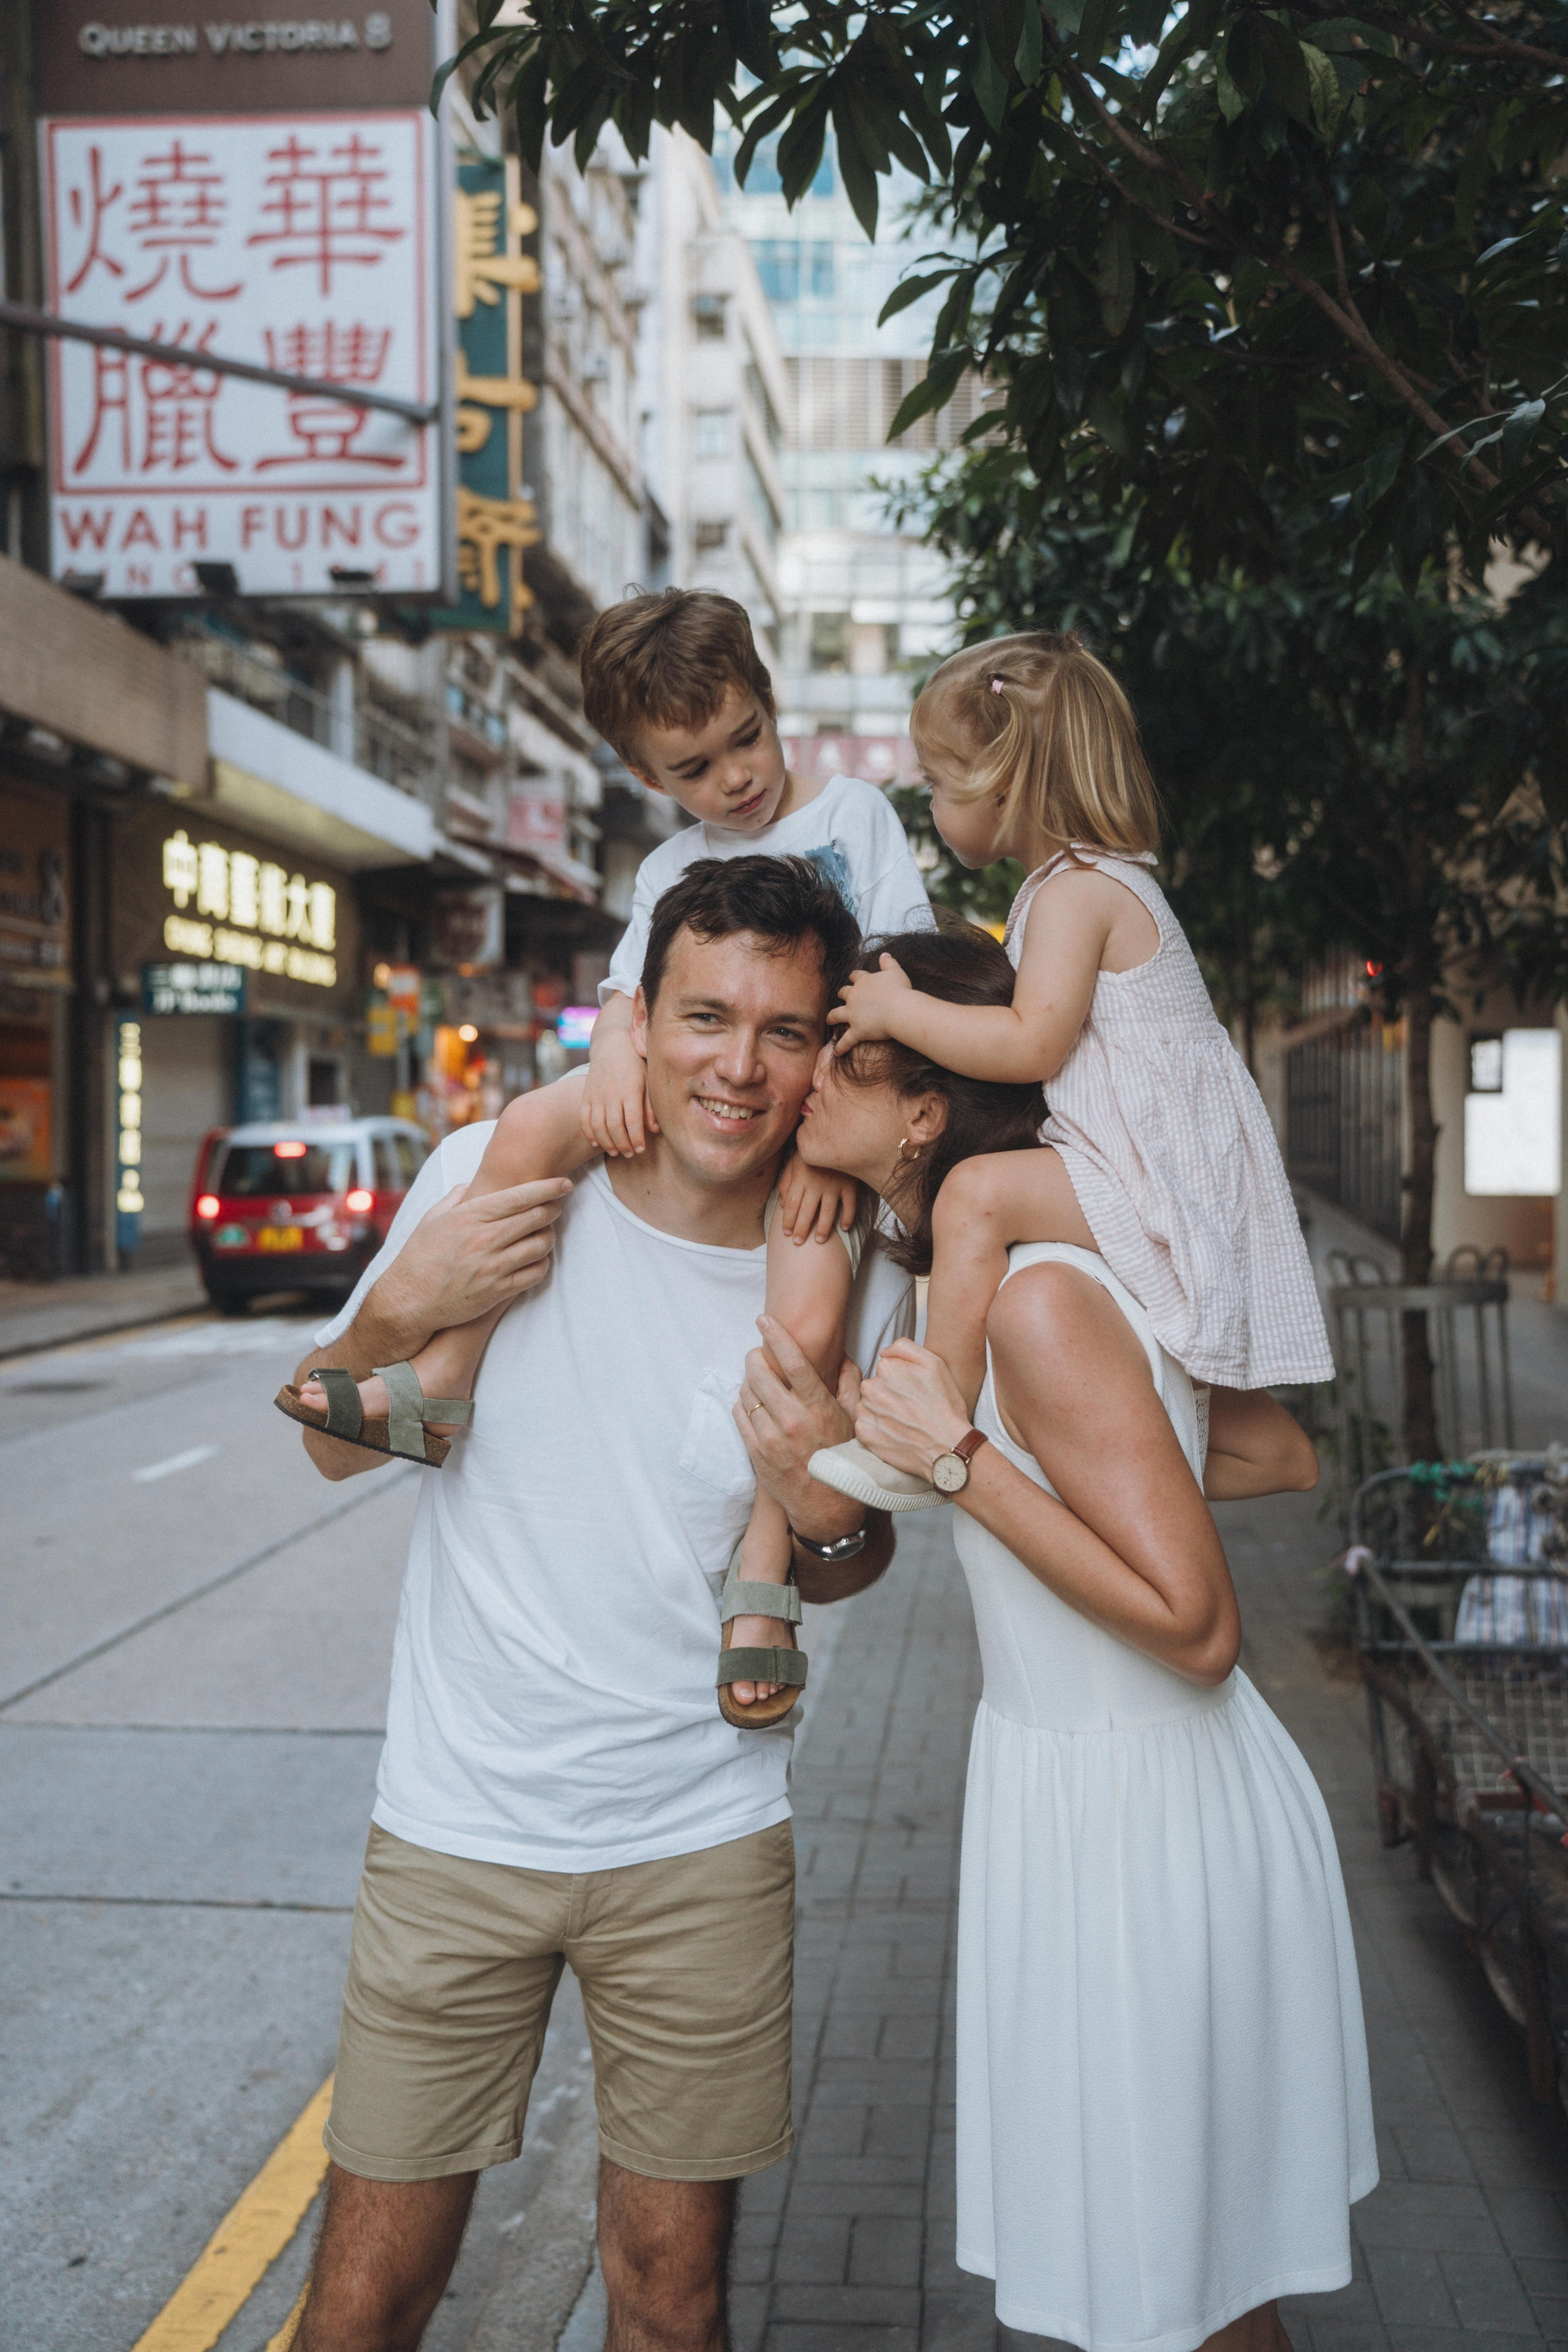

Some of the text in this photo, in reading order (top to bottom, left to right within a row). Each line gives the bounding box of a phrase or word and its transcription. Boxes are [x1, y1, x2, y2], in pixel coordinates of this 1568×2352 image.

[78, 21, 198, 56] QUEEN
[203, 20, 360, 53] VICTORIA
[61, 502, 422, 552] WAH FUNG
